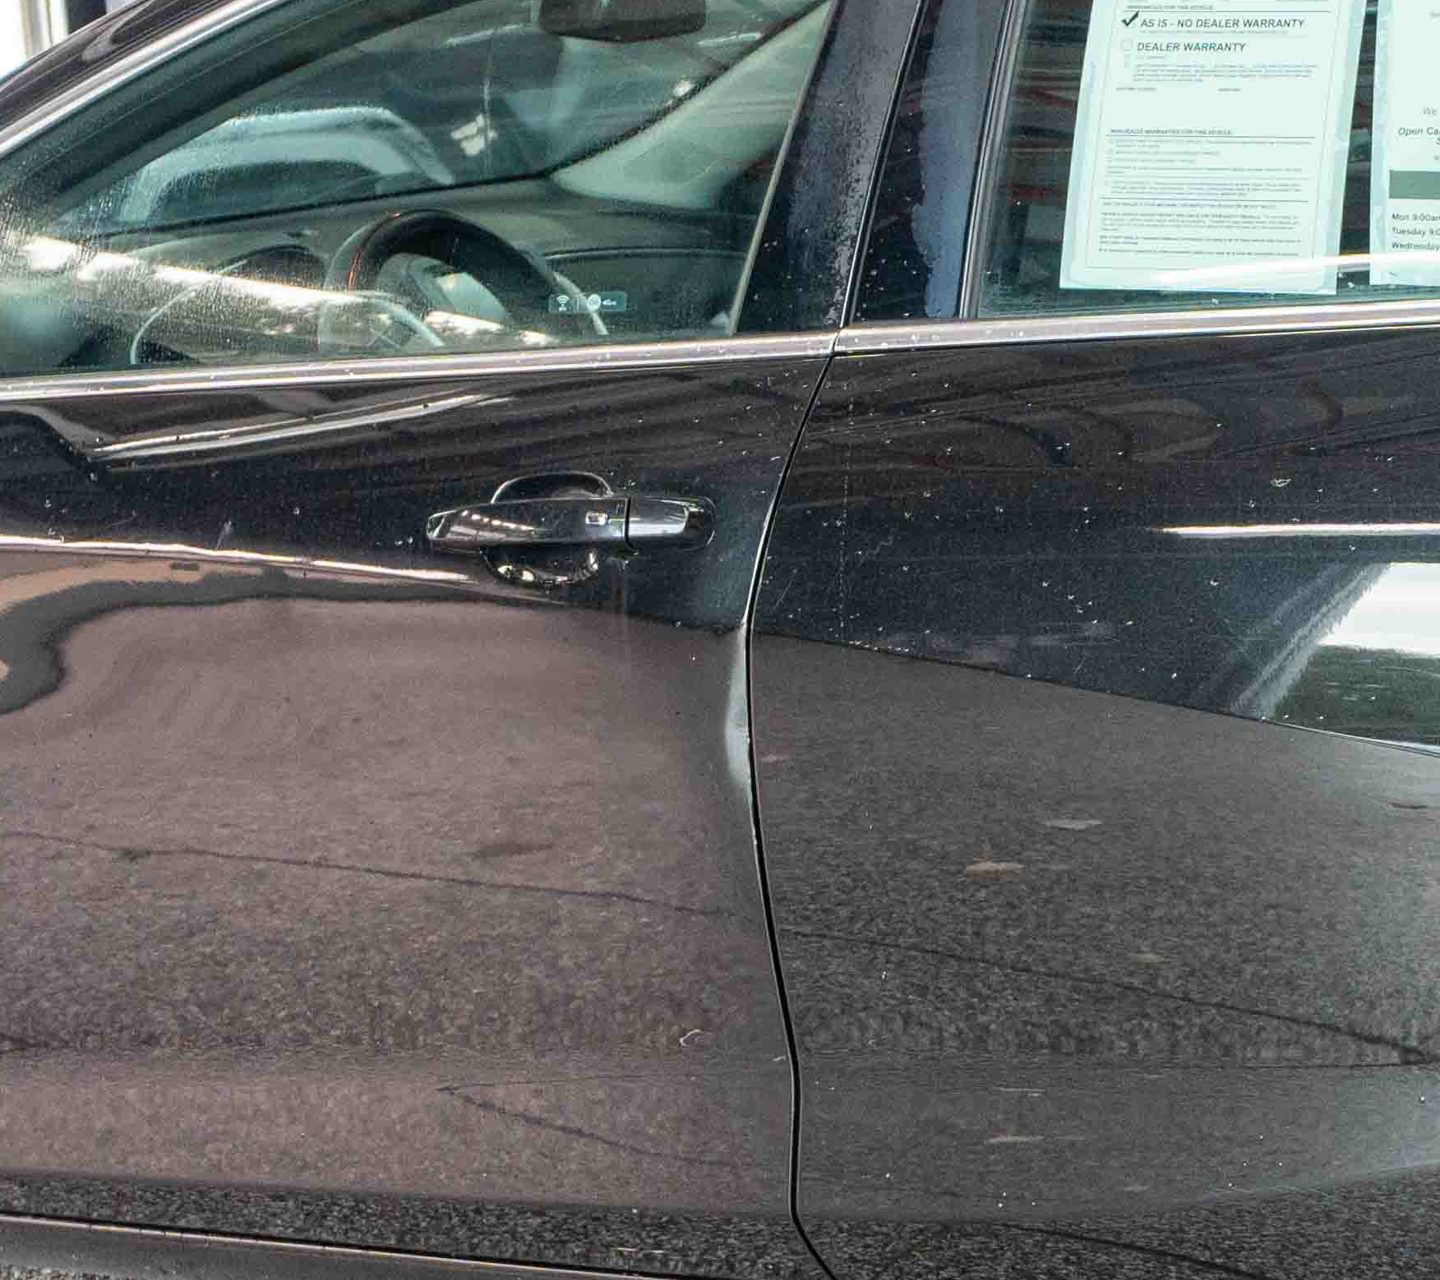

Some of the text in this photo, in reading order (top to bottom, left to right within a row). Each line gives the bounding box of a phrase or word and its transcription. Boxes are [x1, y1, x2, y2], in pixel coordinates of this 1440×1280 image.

[1140, 19, 1156, 29] AS
[1157, 19, 1168, 28] IS
[1177, 19, 1193, 28] NO
[1195, 19, 1240, 29] DEALER
[1242, 19, 1305, 29] WARRANTY
[1137, 42, 1246, 52] DEALER WARRANTY
[1398, 127, 1423, 137] Open
[1392, 213, 1409, 222] Mon
[1392, 227, 1427, 239] Tuesday
[1392, 241, 1440, 252] Wednesday
